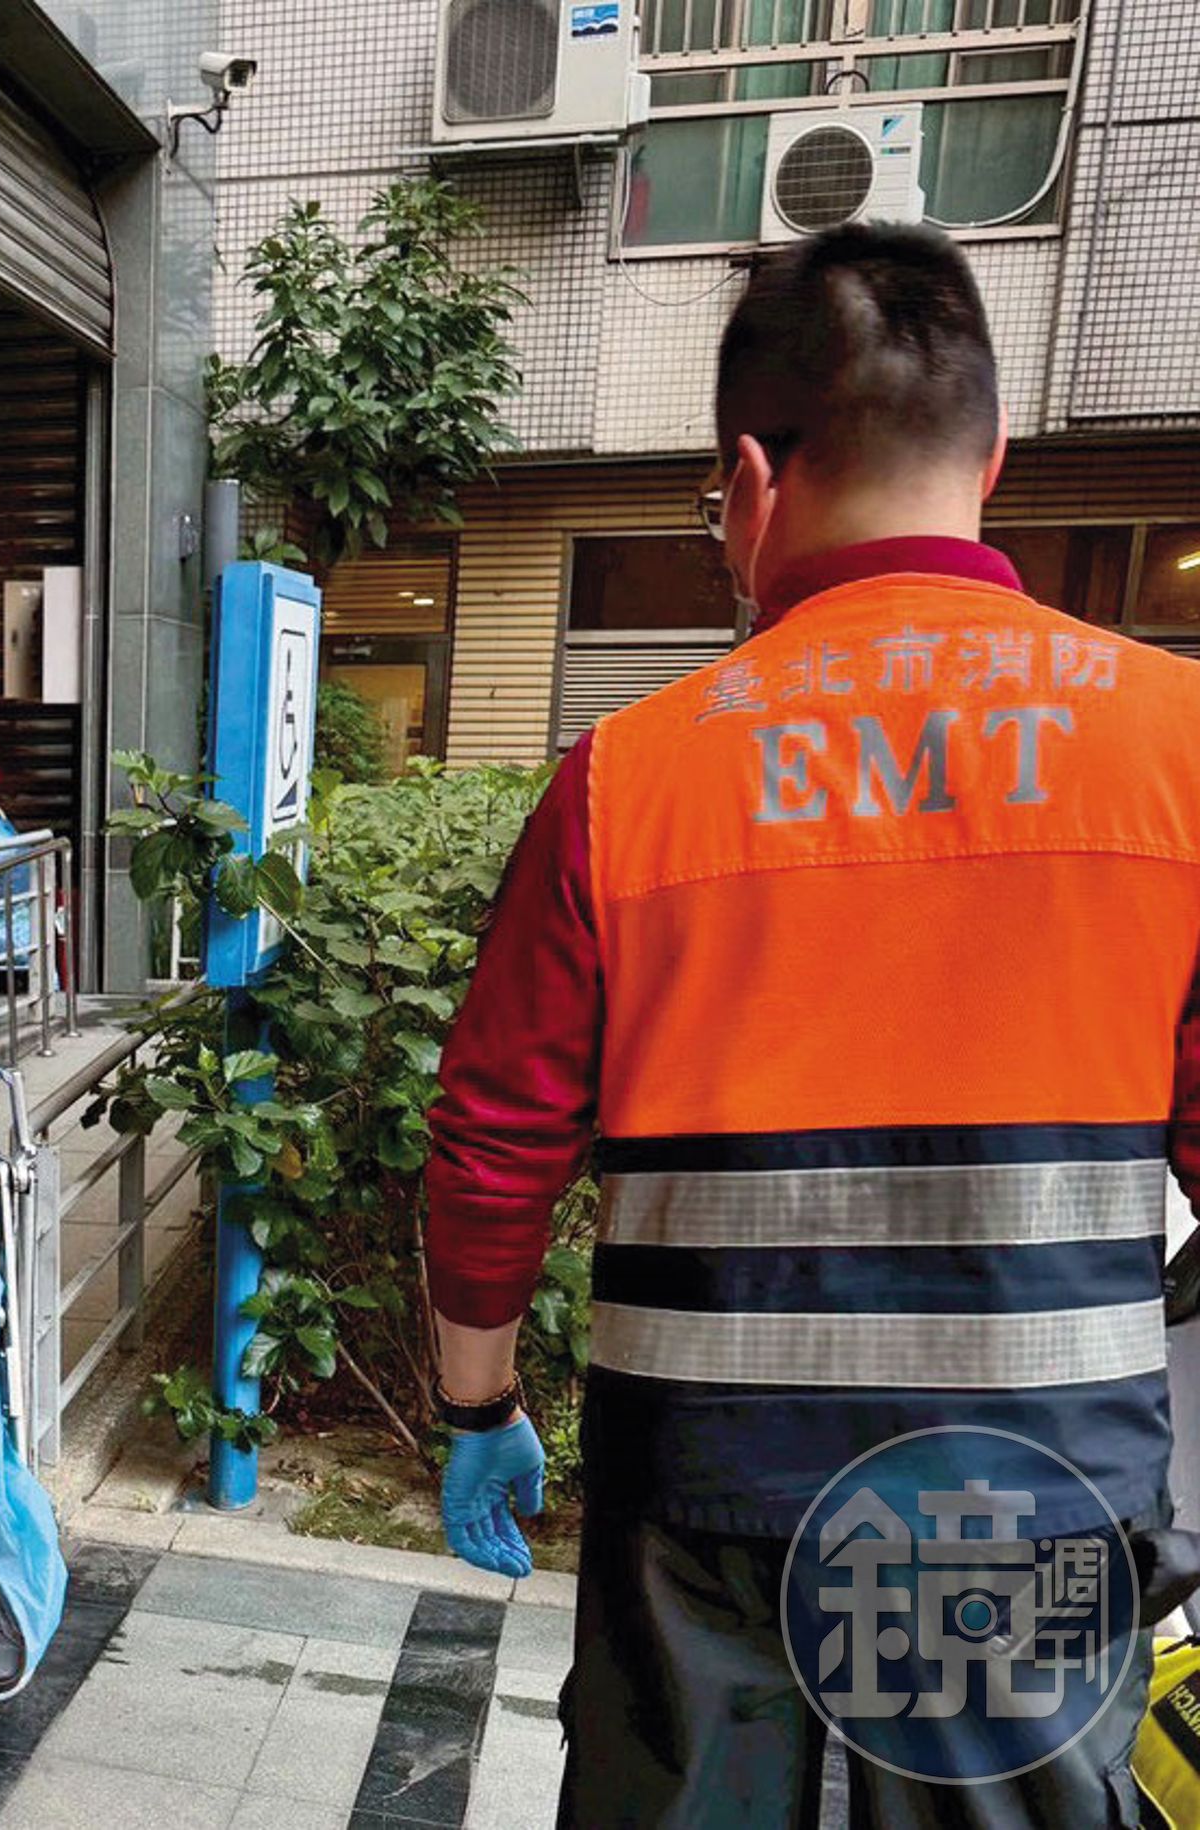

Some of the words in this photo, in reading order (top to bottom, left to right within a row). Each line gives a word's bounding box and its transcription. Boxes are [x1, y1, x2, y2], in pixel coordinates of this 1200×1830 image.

[695, 625, 1124, 723] 臺北市消防
[752, 704, 1075, 825] EMT
